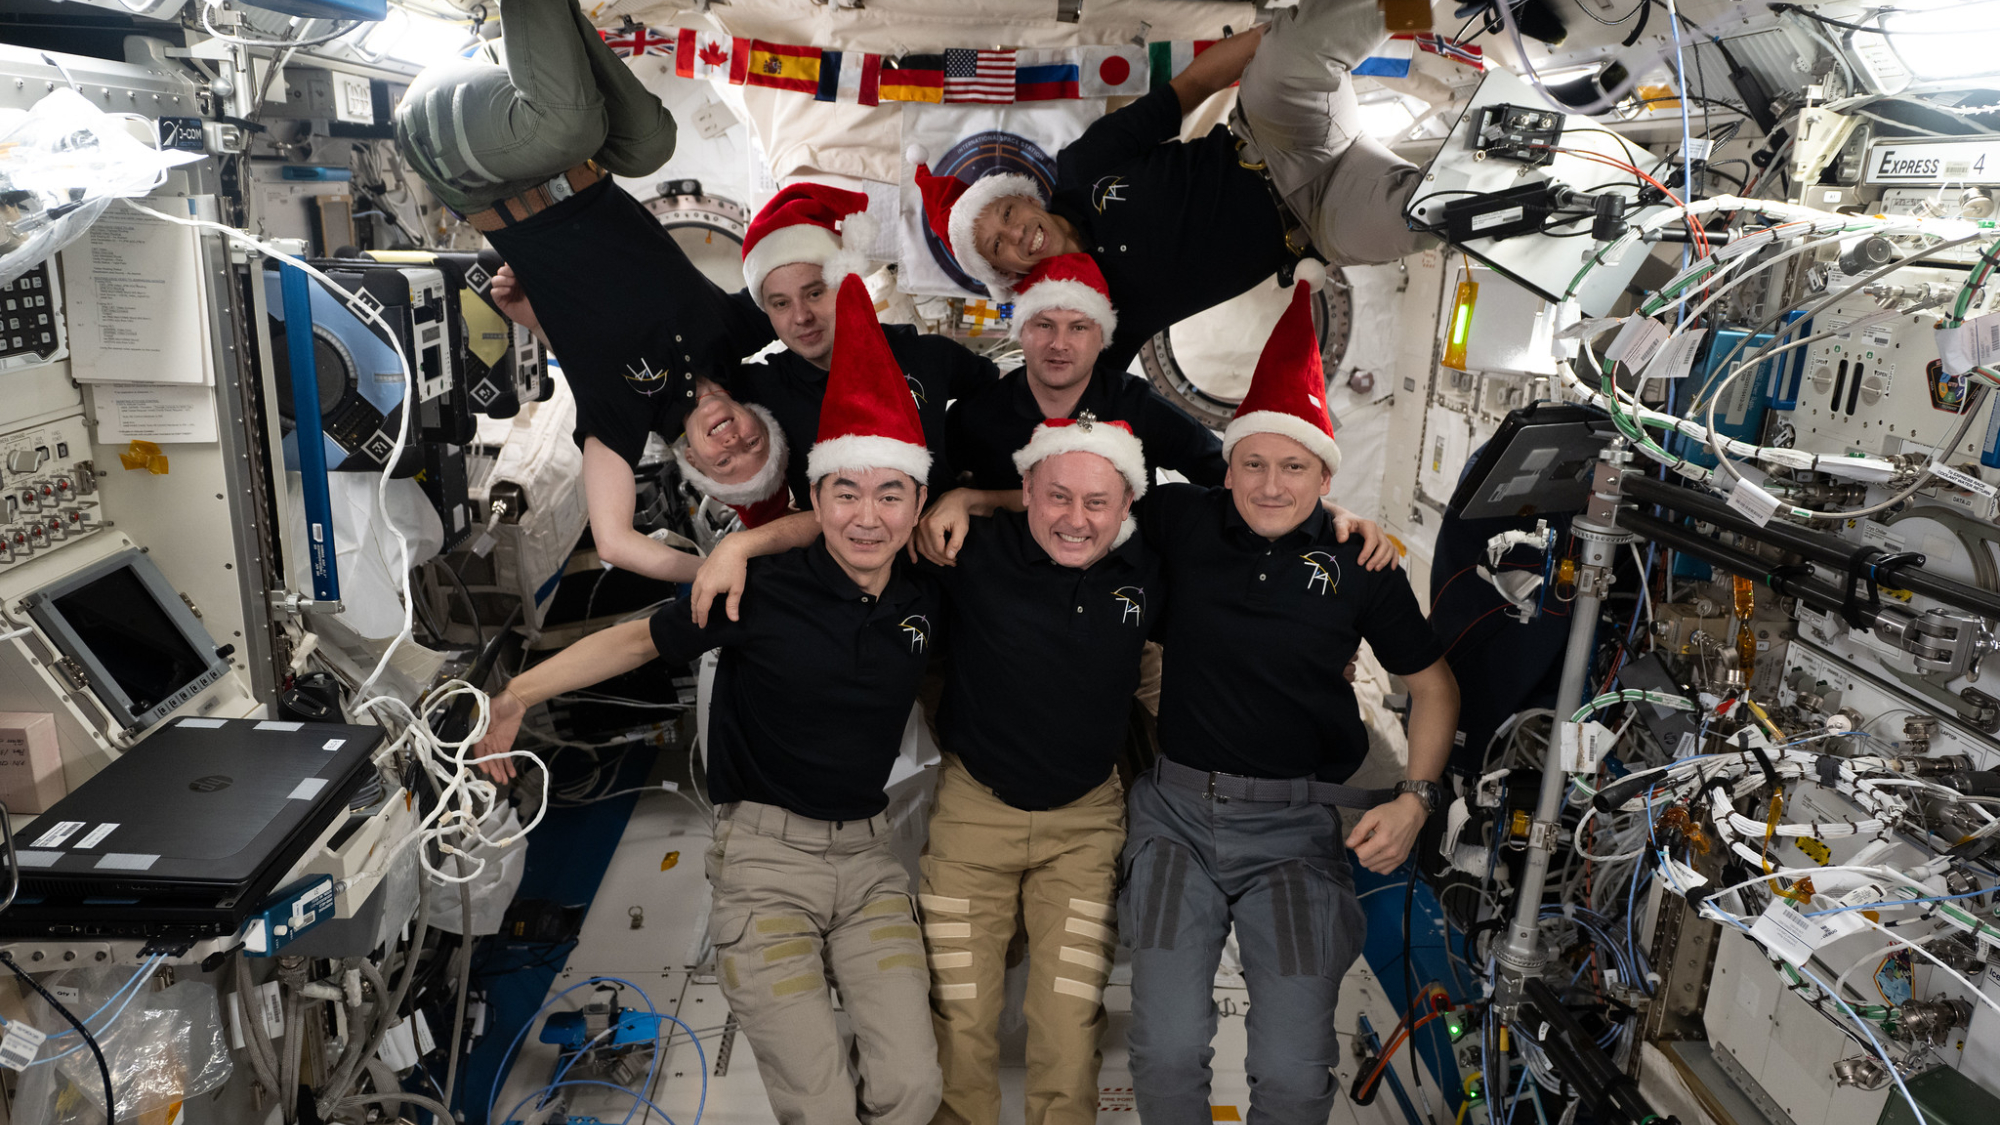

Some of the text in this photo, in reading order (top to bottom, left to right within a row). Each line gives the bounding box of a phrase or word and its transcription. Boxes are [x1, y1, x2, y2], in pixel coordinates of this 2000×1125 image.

[1000, 134, 1020, 145] SPACE
[1020, 141, 1045, 161] STATION
[1878, 150, 1986, 175] EXPRESS 4
[1953, 472, 1974, 483] EXPRESS
[1957, 479, 1973, 489] WATER
[1973, 486, 1991, 496] RETURN
